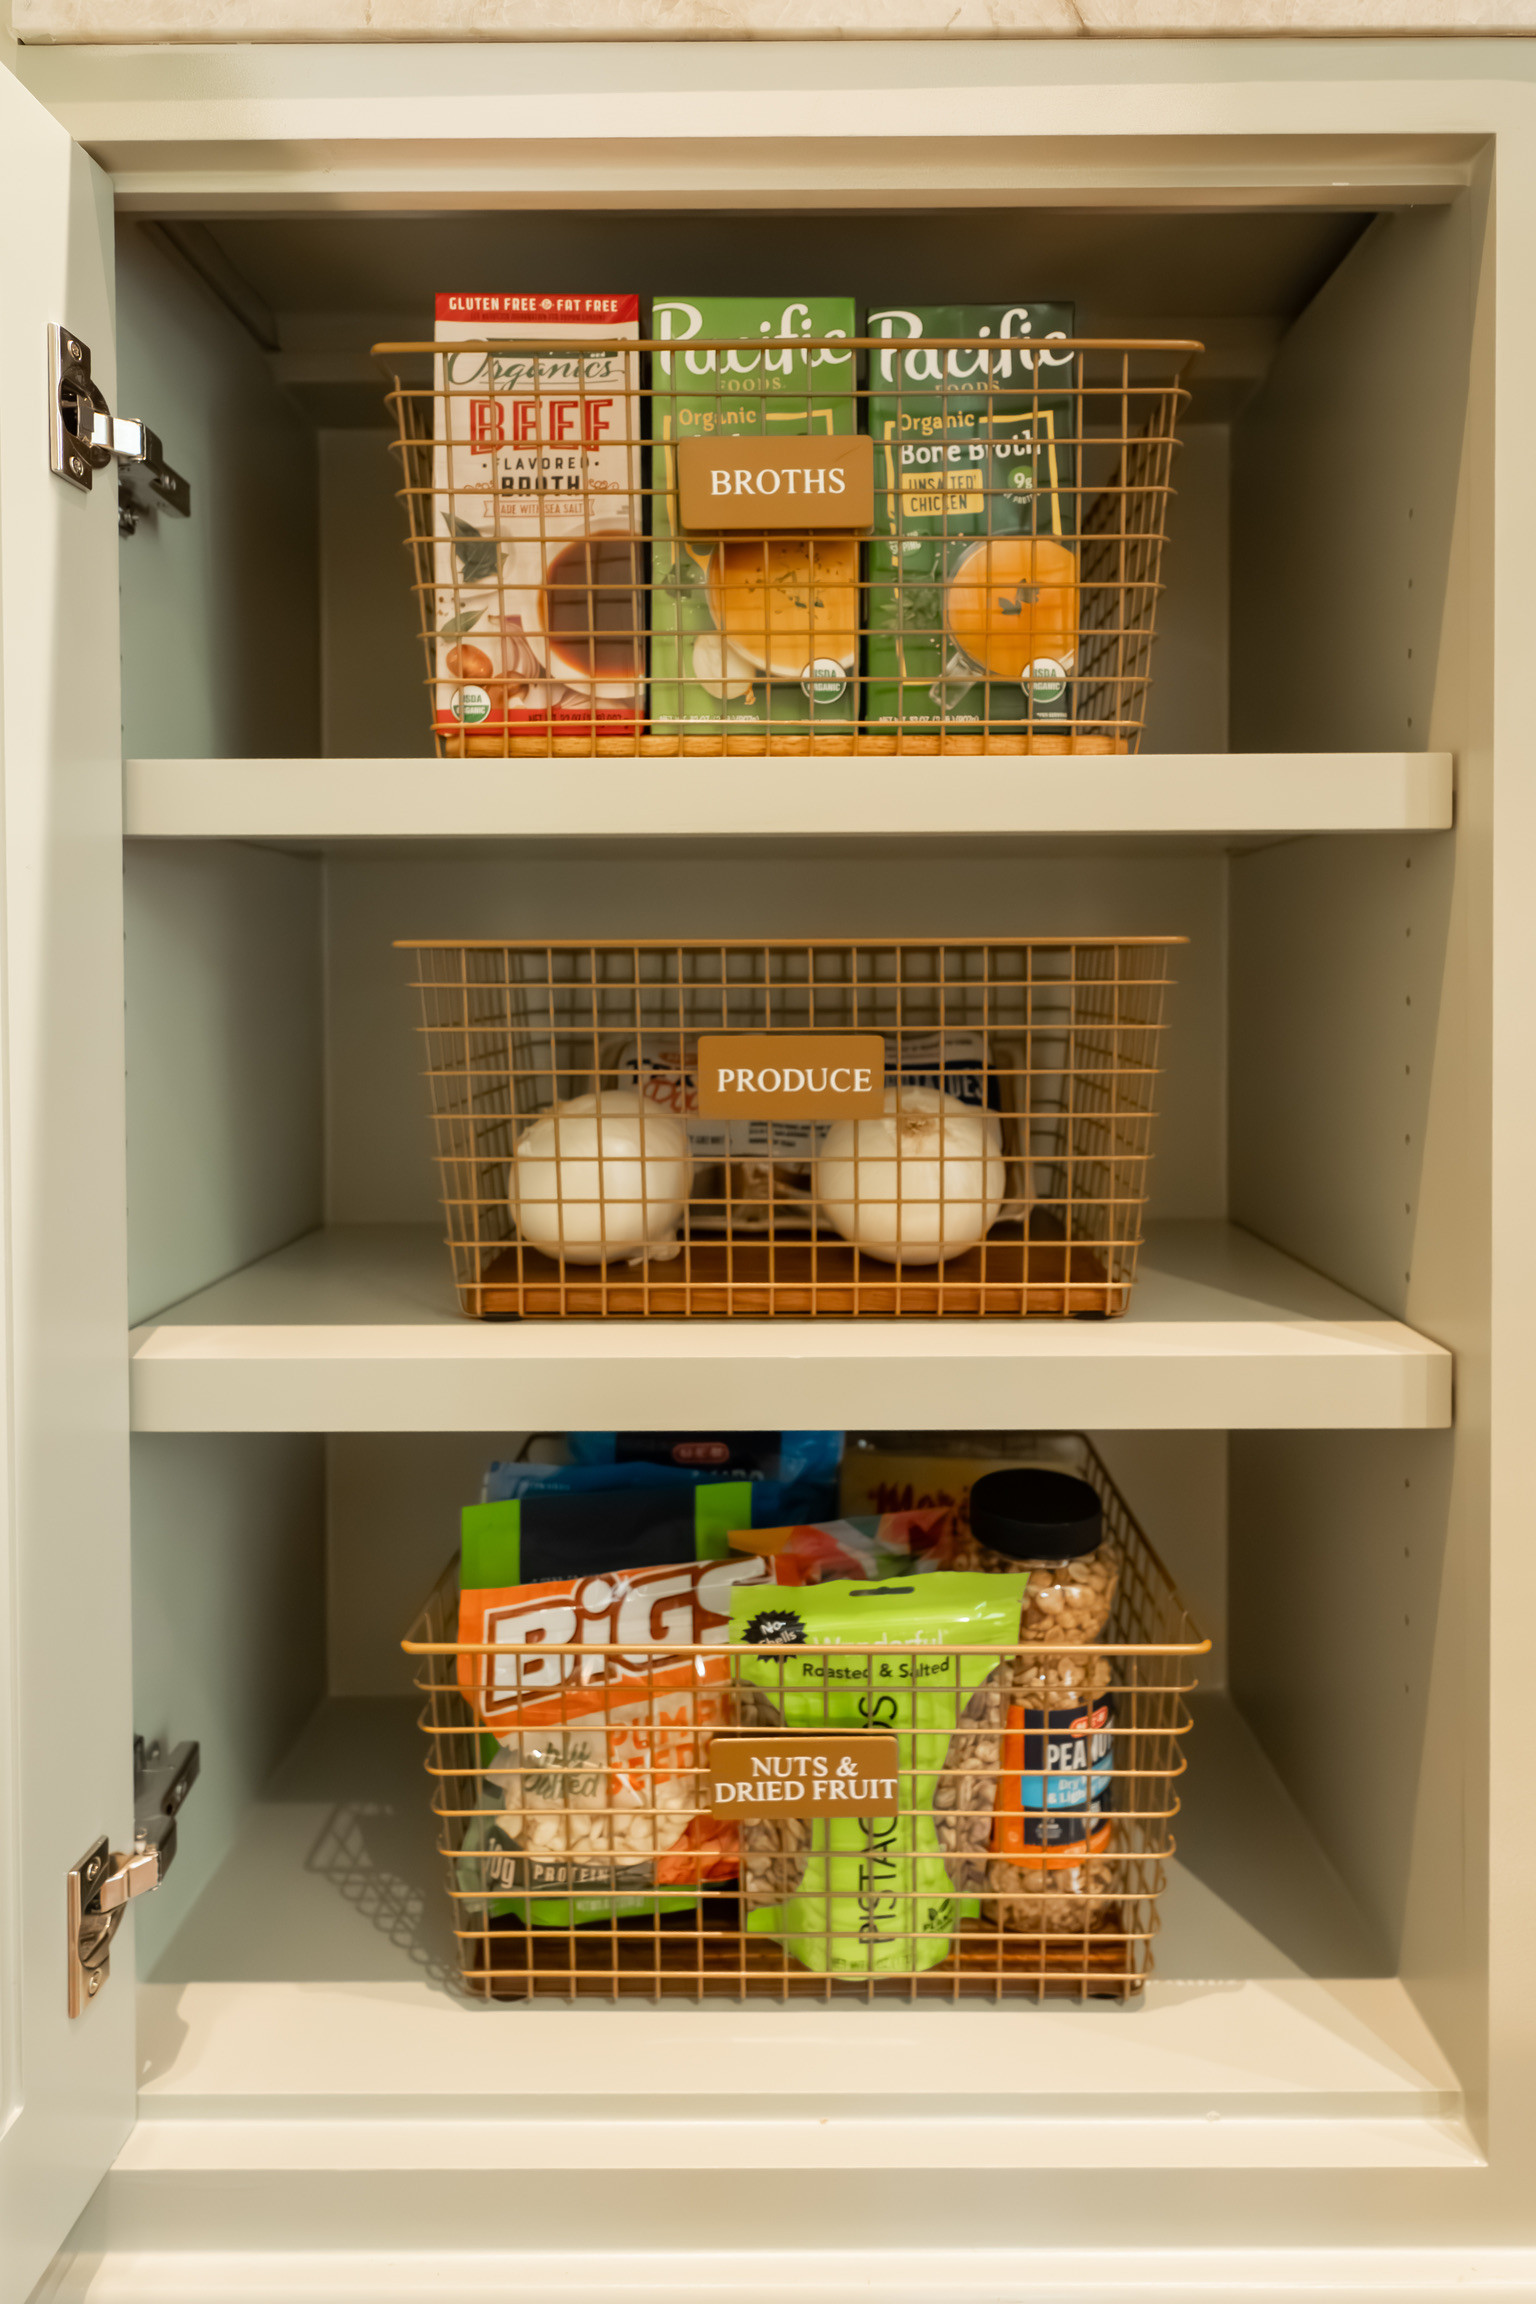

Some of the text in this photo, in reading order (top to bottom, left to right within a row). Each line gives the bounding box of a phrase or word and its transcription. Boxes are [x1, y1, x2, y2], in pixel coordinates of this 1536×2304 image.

[449, 296, 499, 311] GLUTEN
[503, 297, 537, 311] FREE
[556, 299, 582, 312] FAT
[585, 300, 618, 312] FREE
[652, 302, 852, 376] Pacific
[867, 308, 1075, 383] Pacific
[469, 399, 614, 455] BEEF
[901, 411, 975, 436] Organic
[901, 440, 962, 465] Bone
[494, 457, 590, 470] LAVORE
[710, 467, 846, 496] BROTHS
[909, 475, 975, 491] UNSATED
[497, 504, 516, 514] ADE
[911, 495, 967, 512] CHICEN
[456, 706, 486, 715] OGANIC
[716, 1067, 873, 1093] PRODUCE
[760, 1620, 785, 1635] No
[879, 1663, 893, 1678] &
[751, 1756, 859, 1777] NUTS &
[714, 1778, 898, 1803] DRIED FRUIT
